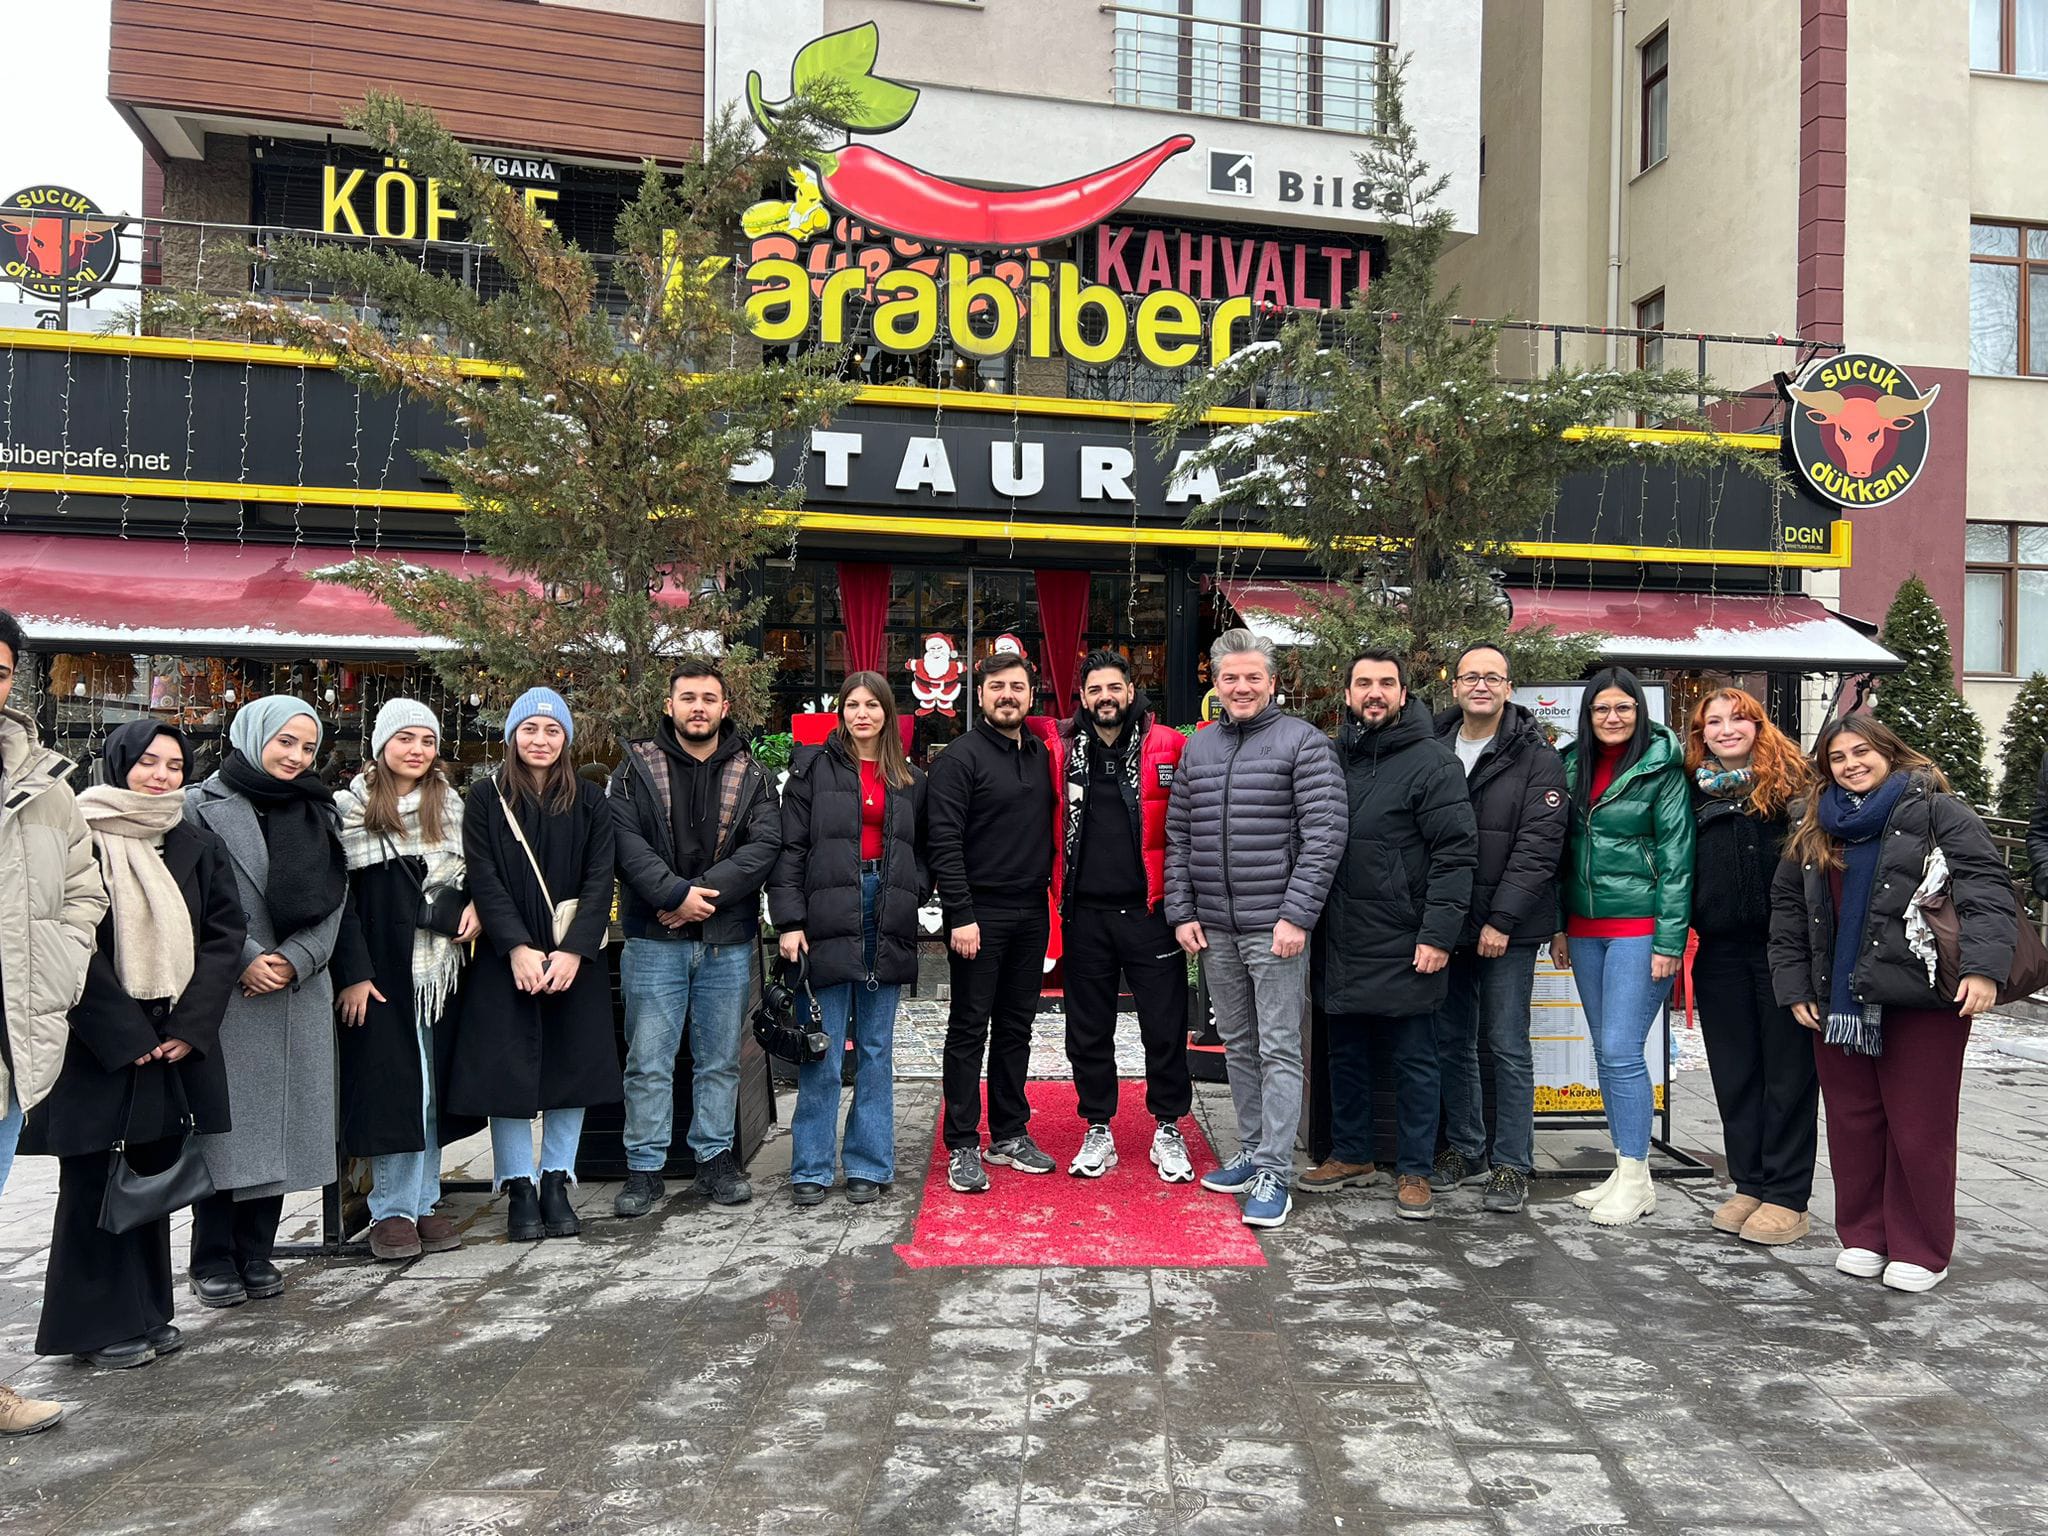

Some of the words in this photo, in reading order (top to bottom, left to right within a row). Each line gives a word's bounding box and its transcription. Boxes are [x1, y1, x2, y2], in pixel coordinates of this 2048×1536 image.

[16, 189, 91, 214] SUCUK
[323, 157, 559, 250] KÖFE
[1098, 224, 1371, 310] KAHVALTI
[1820, 360, 1901, 395] SUCUK
[1810, 461, 1910, 502] dükkanı
[1785, 526, 1824, 544] DGN
[1529, 706, 1571, 716] arabiber
[1569, 1088, 1601, 1098] karabi
